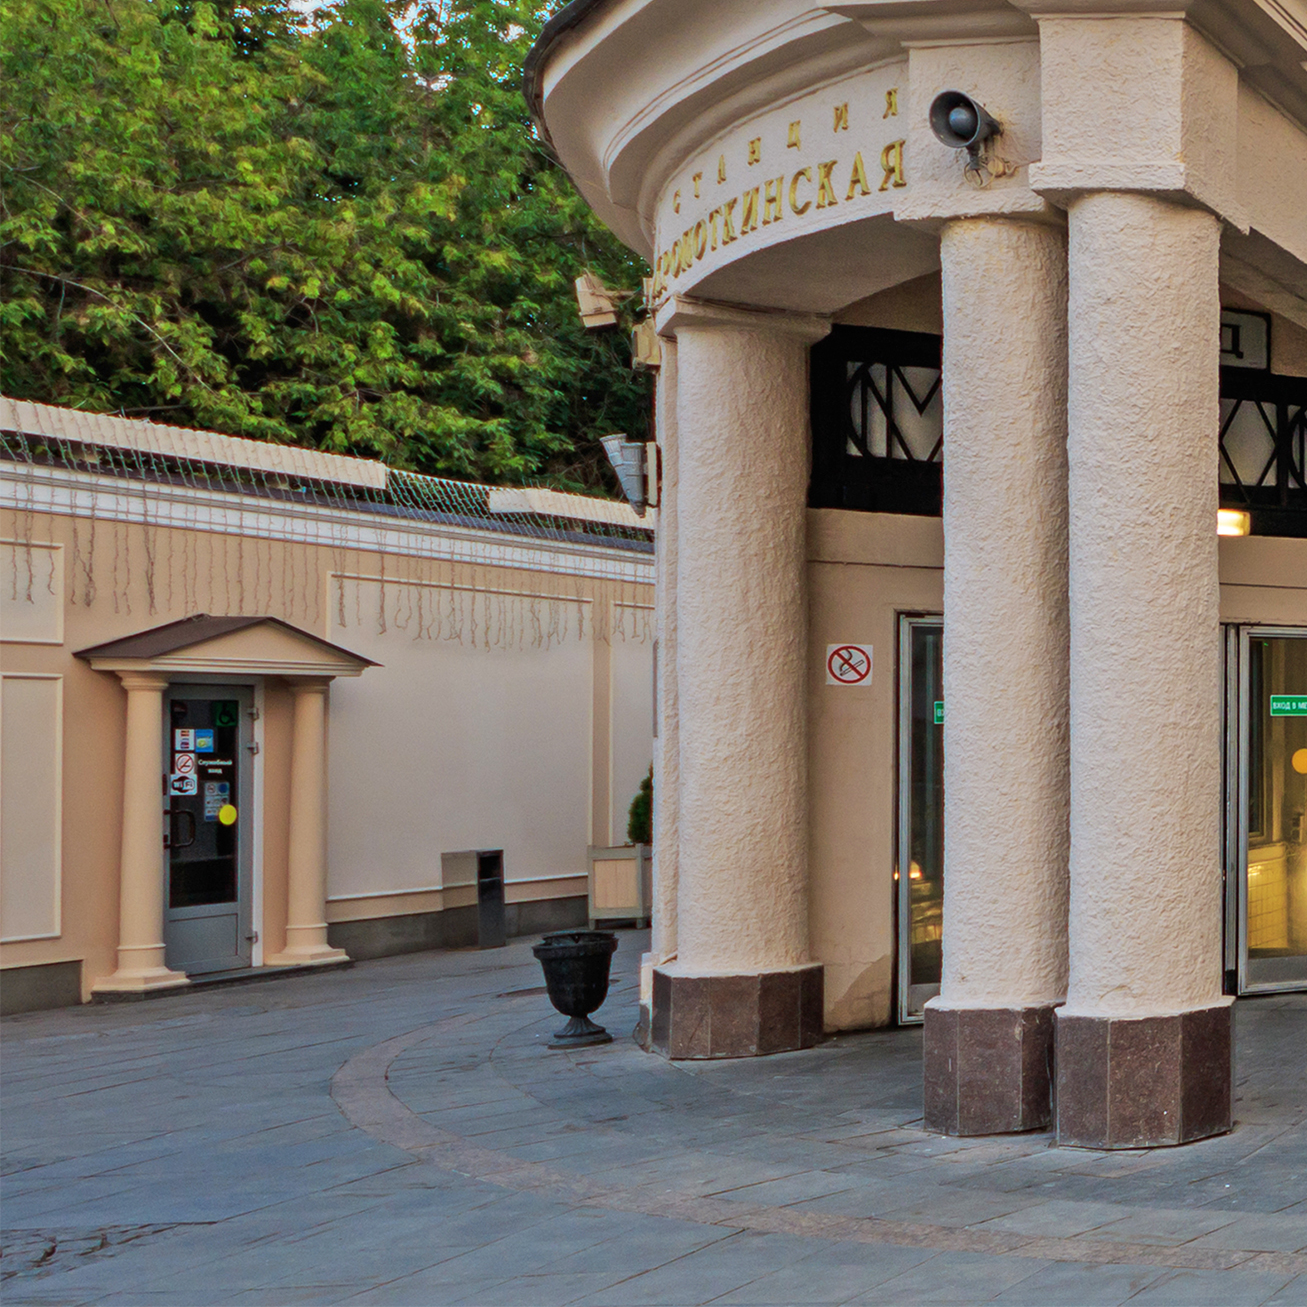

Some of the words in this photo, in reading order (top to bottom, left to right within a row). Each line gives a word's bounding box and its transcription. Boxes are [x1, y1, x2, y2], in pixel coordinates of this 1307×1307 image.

[673, 87, 899, 215] СТАНЦИЯ
[1272, 701, 1291, 711] ВХОД
[1291, 701, 1297, 710] В
